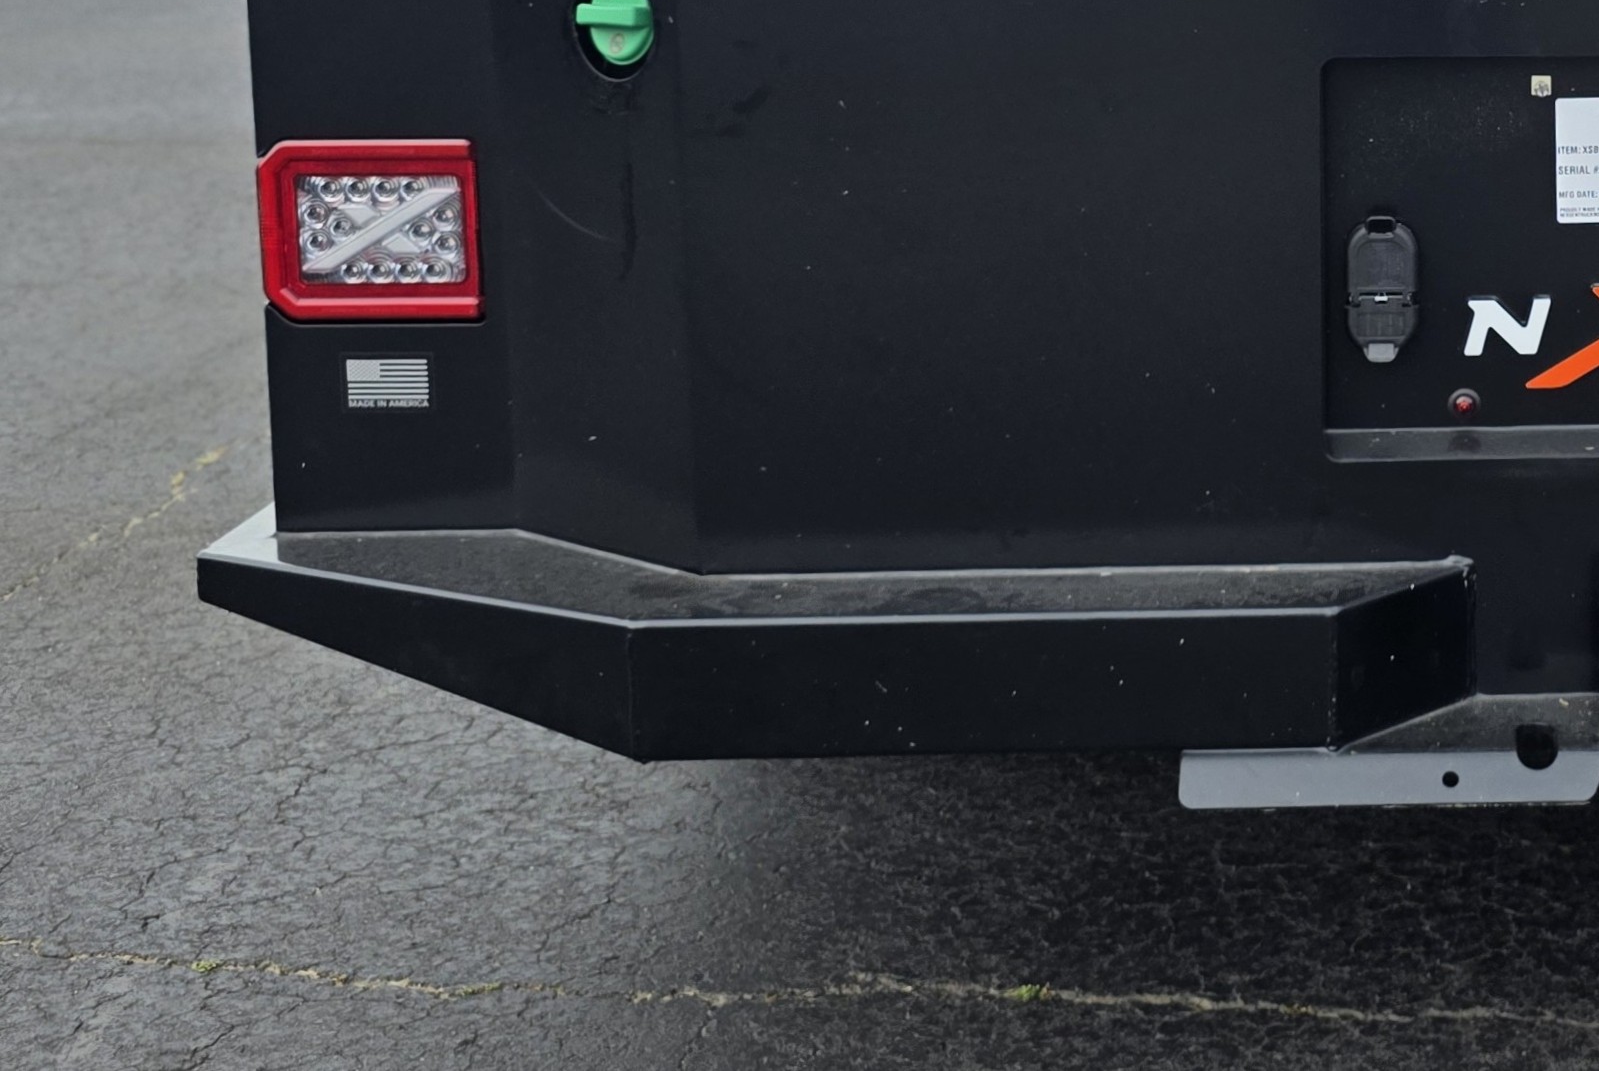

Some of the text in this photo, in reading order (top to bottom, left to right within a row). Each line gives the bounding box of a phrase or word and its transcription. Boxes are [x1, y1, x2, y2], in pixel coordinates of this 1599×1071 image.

[1558, 145, 1580, 155] ITEM:
[1558, 166, 1590, 175] SERIAL
[1559, 190, 1575, 198] MFG
[1577, 190, 1598, 198] DATE:
[349, 399, 429, 408] MADE IN AMERICA
